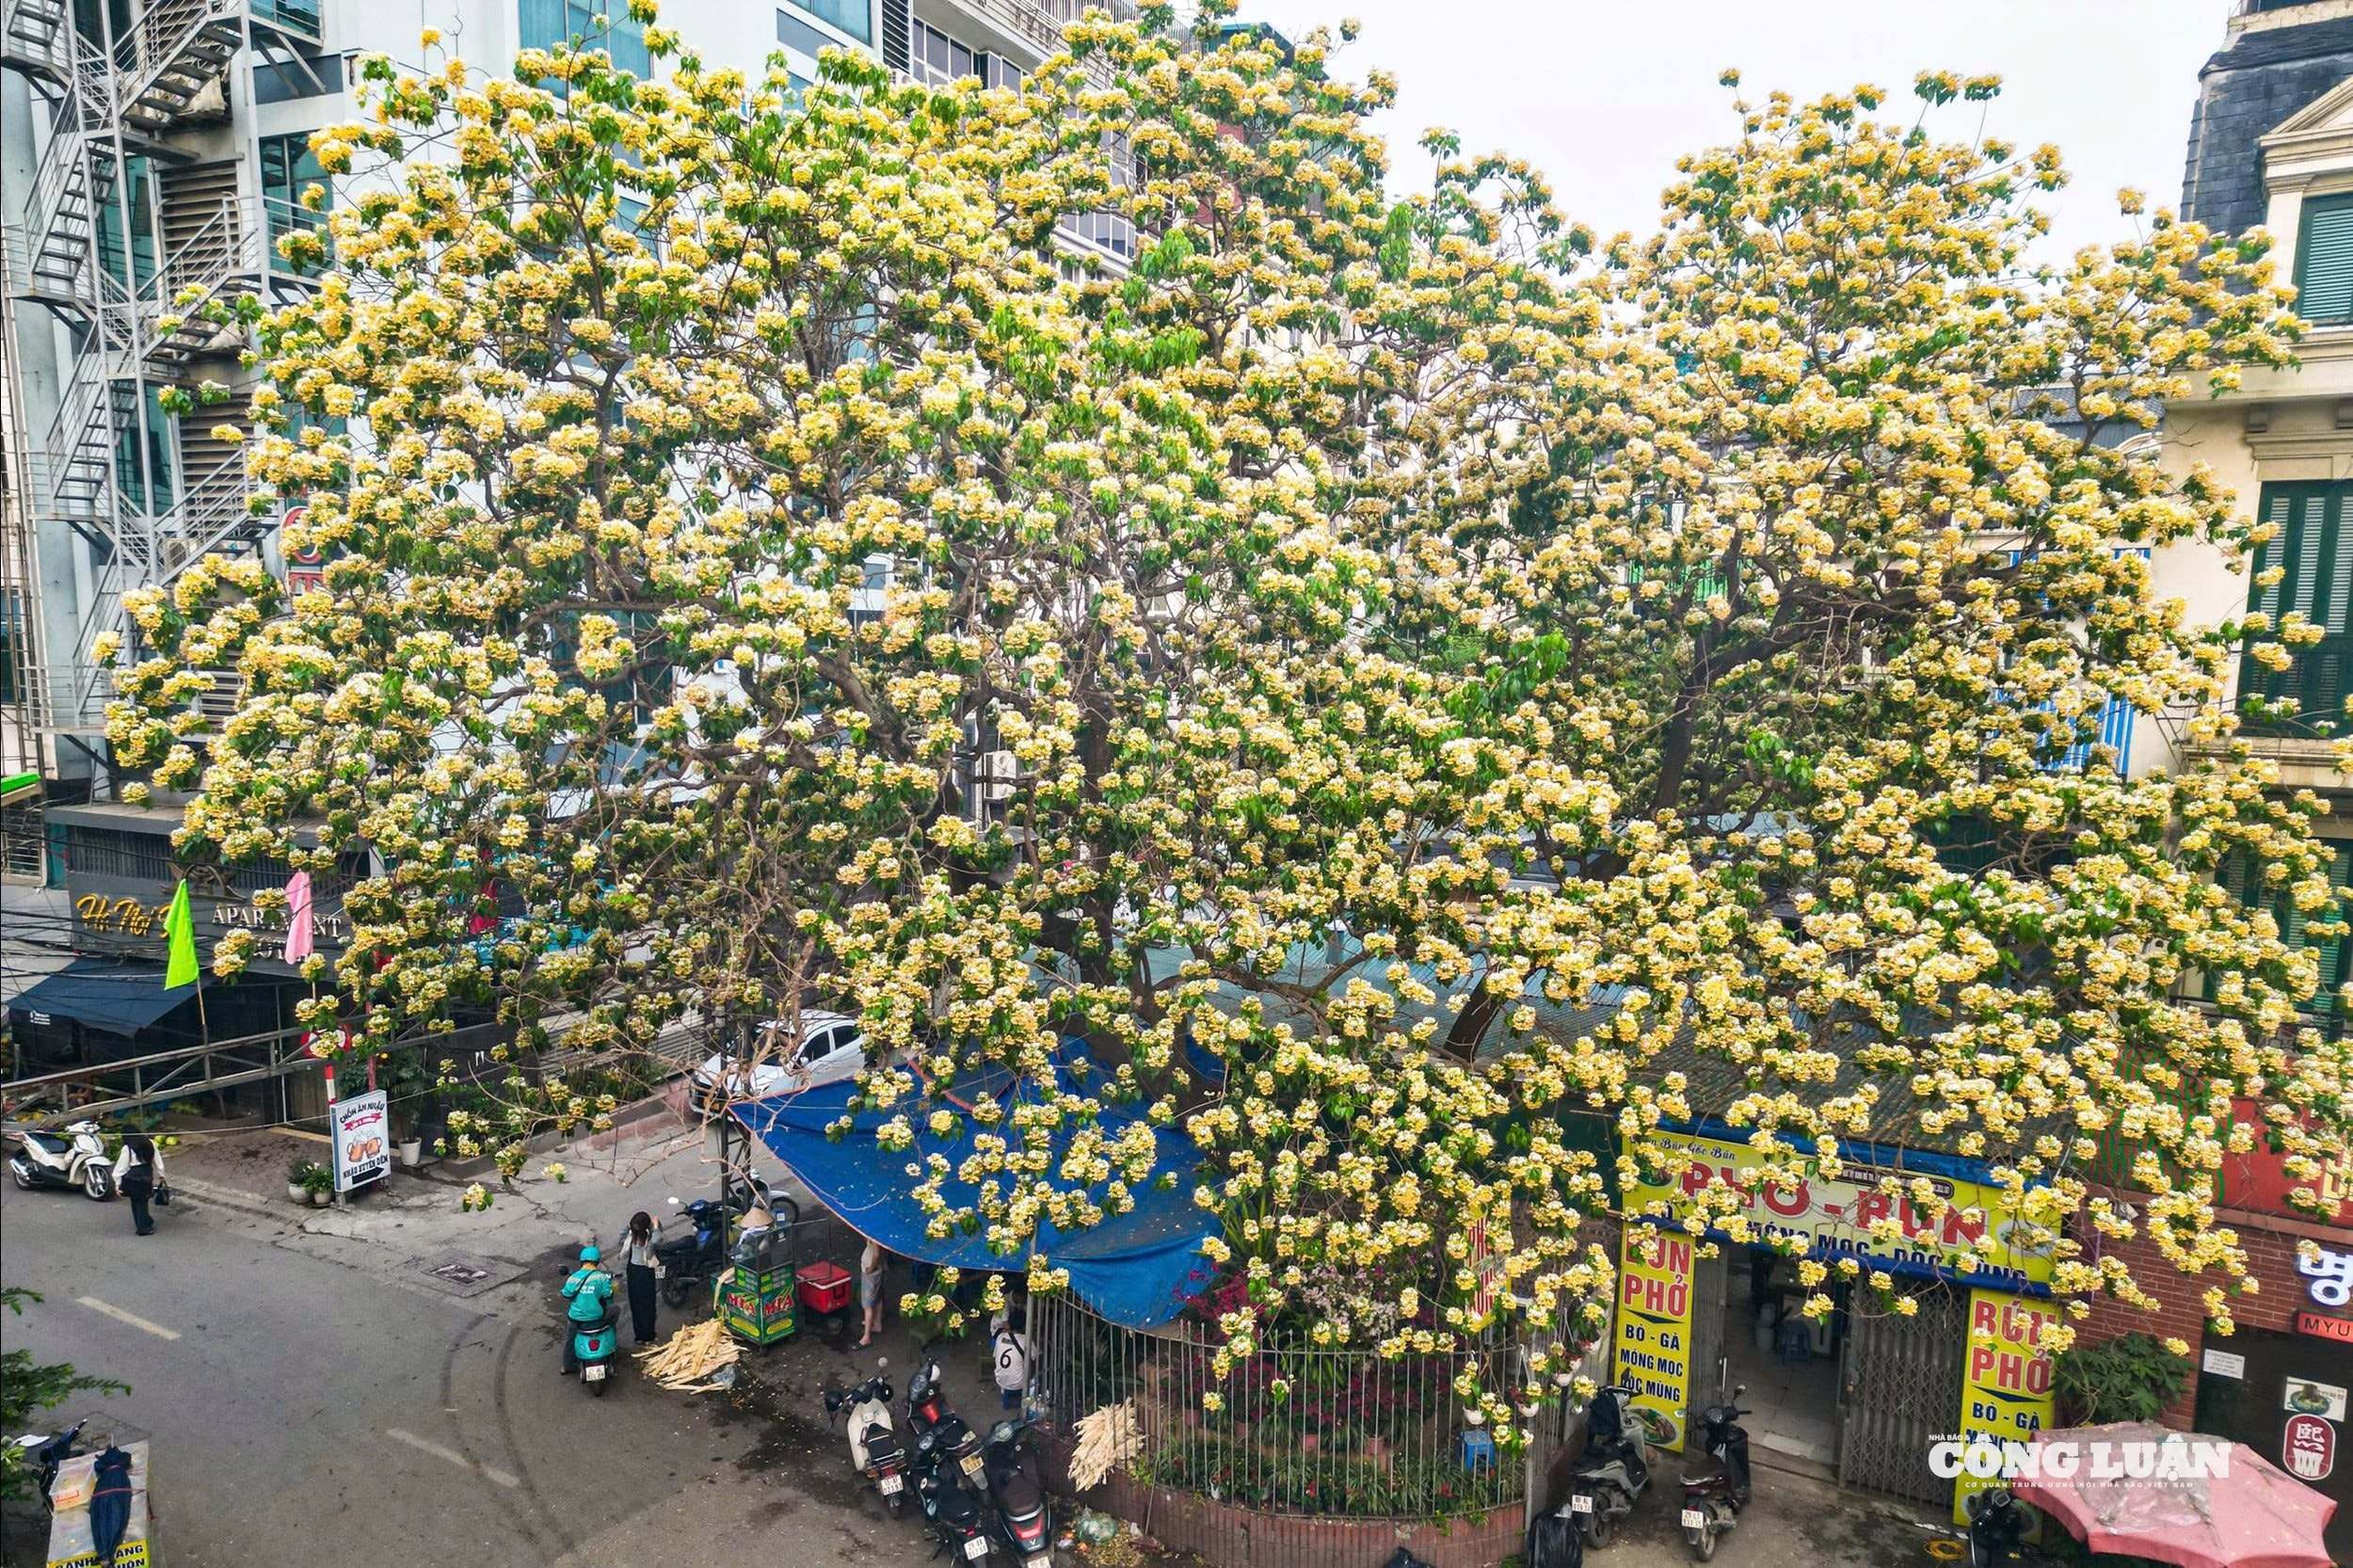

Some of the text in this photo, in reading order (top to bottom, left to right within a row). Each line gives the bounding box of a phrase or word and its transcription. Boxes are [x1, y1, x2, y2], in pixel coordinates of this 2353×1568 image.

[1710, 1145, 1737, 1160] Bún
[1625, 1273, 1689, 1318] PHỞ
[1625, 1322, 1645, 1342] BÒ
[1659, 1332, 1680, 1352] GÀ
[1000, 1348, 1012, 1369] 6
[1620, 1348, 1684, 1379] MÓNG MỌC
[1971, 1347, 2053, 1396] PHỞ
[1645, 1380, 1680, 1403] MÙNG
[1973, 1401, 1997, 1422] BÒ
[2015, 1412, 2041, 1431] GÀ
